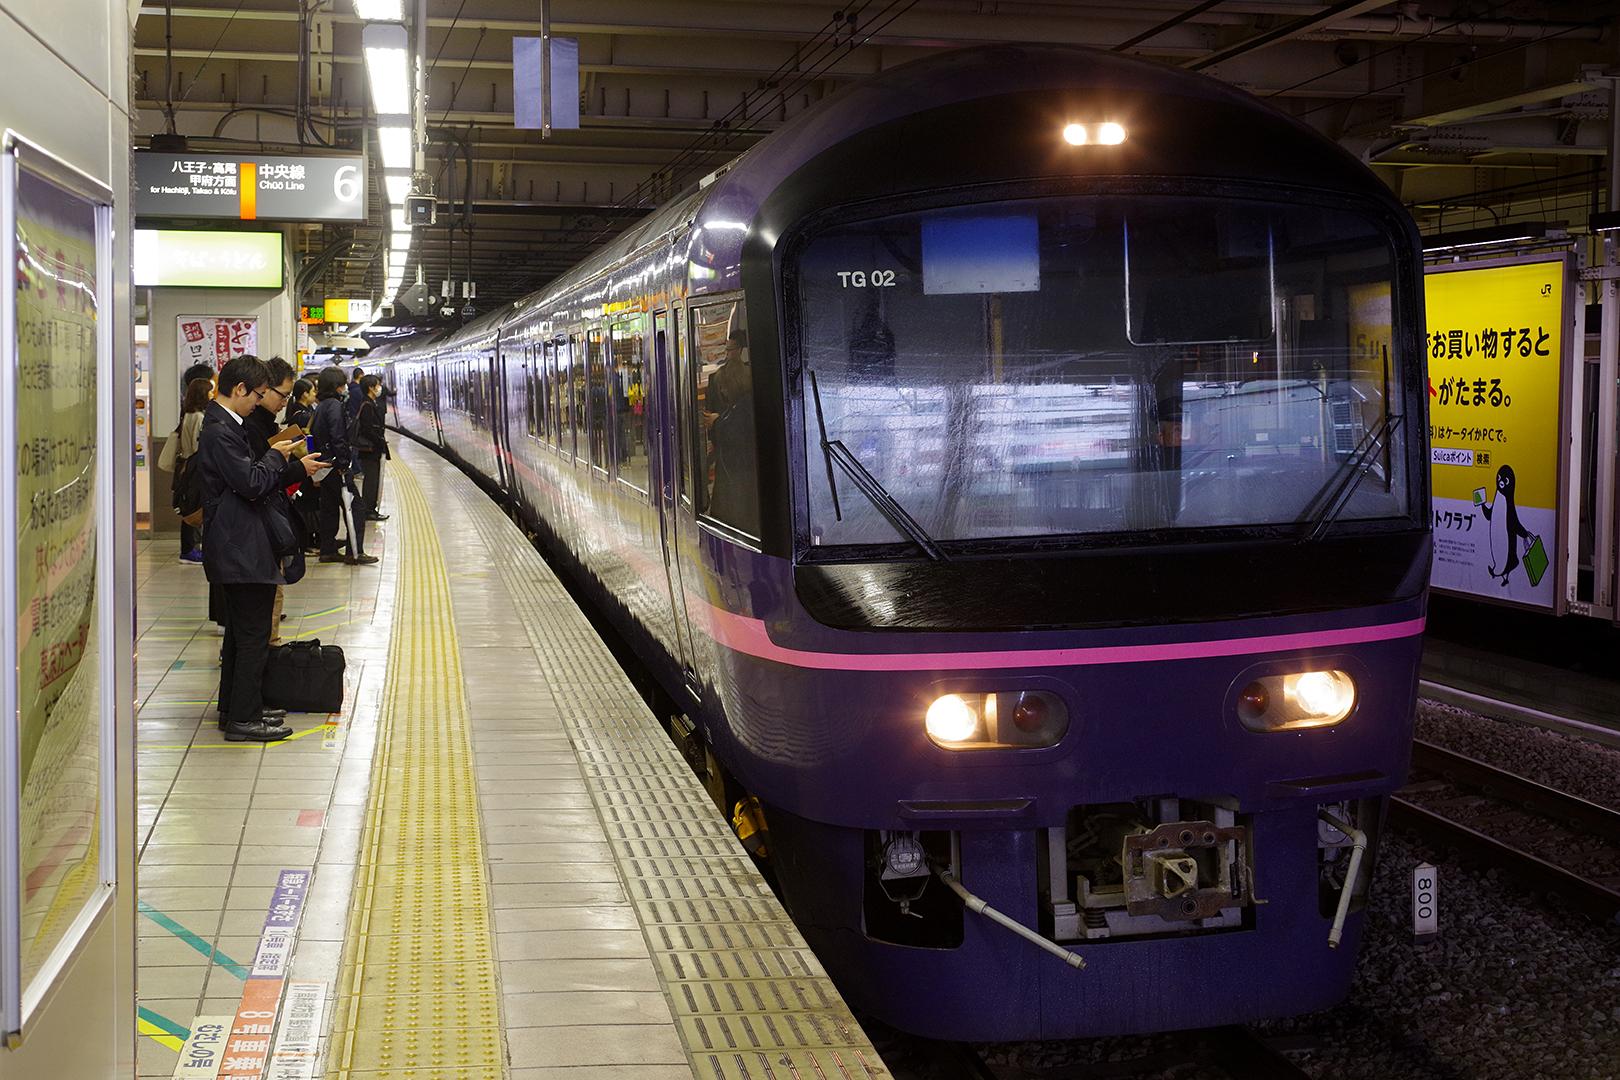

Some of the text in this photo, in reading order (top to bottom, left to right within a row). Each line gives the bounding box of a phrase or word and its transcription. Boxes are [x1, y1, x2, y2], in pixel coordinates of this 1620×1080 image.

[171, 161, 236, 174] 八王子・高尾
[259, 165, 306, 180] 中央線
[190, 174, 236, 187] 甲府方面
[286, 181, 305, 191] Line
[333, 165, 359, 203] 6
[172, 249, 267, 269] そば・うどん
[837, 270, 896, 288] TG 02
[1541, 283, 1552, 295] JR
[1356, 333, 1388, 360] Su
[1433, 450, 1471, 464] Suicaポイント
[1476, 453, 1490, 466] 検索
[1431, 509, 1476, 532] トクラブ
[1418, 878, 1432, 919] 800
[183, 1024, 224, 1068] むさしの号
